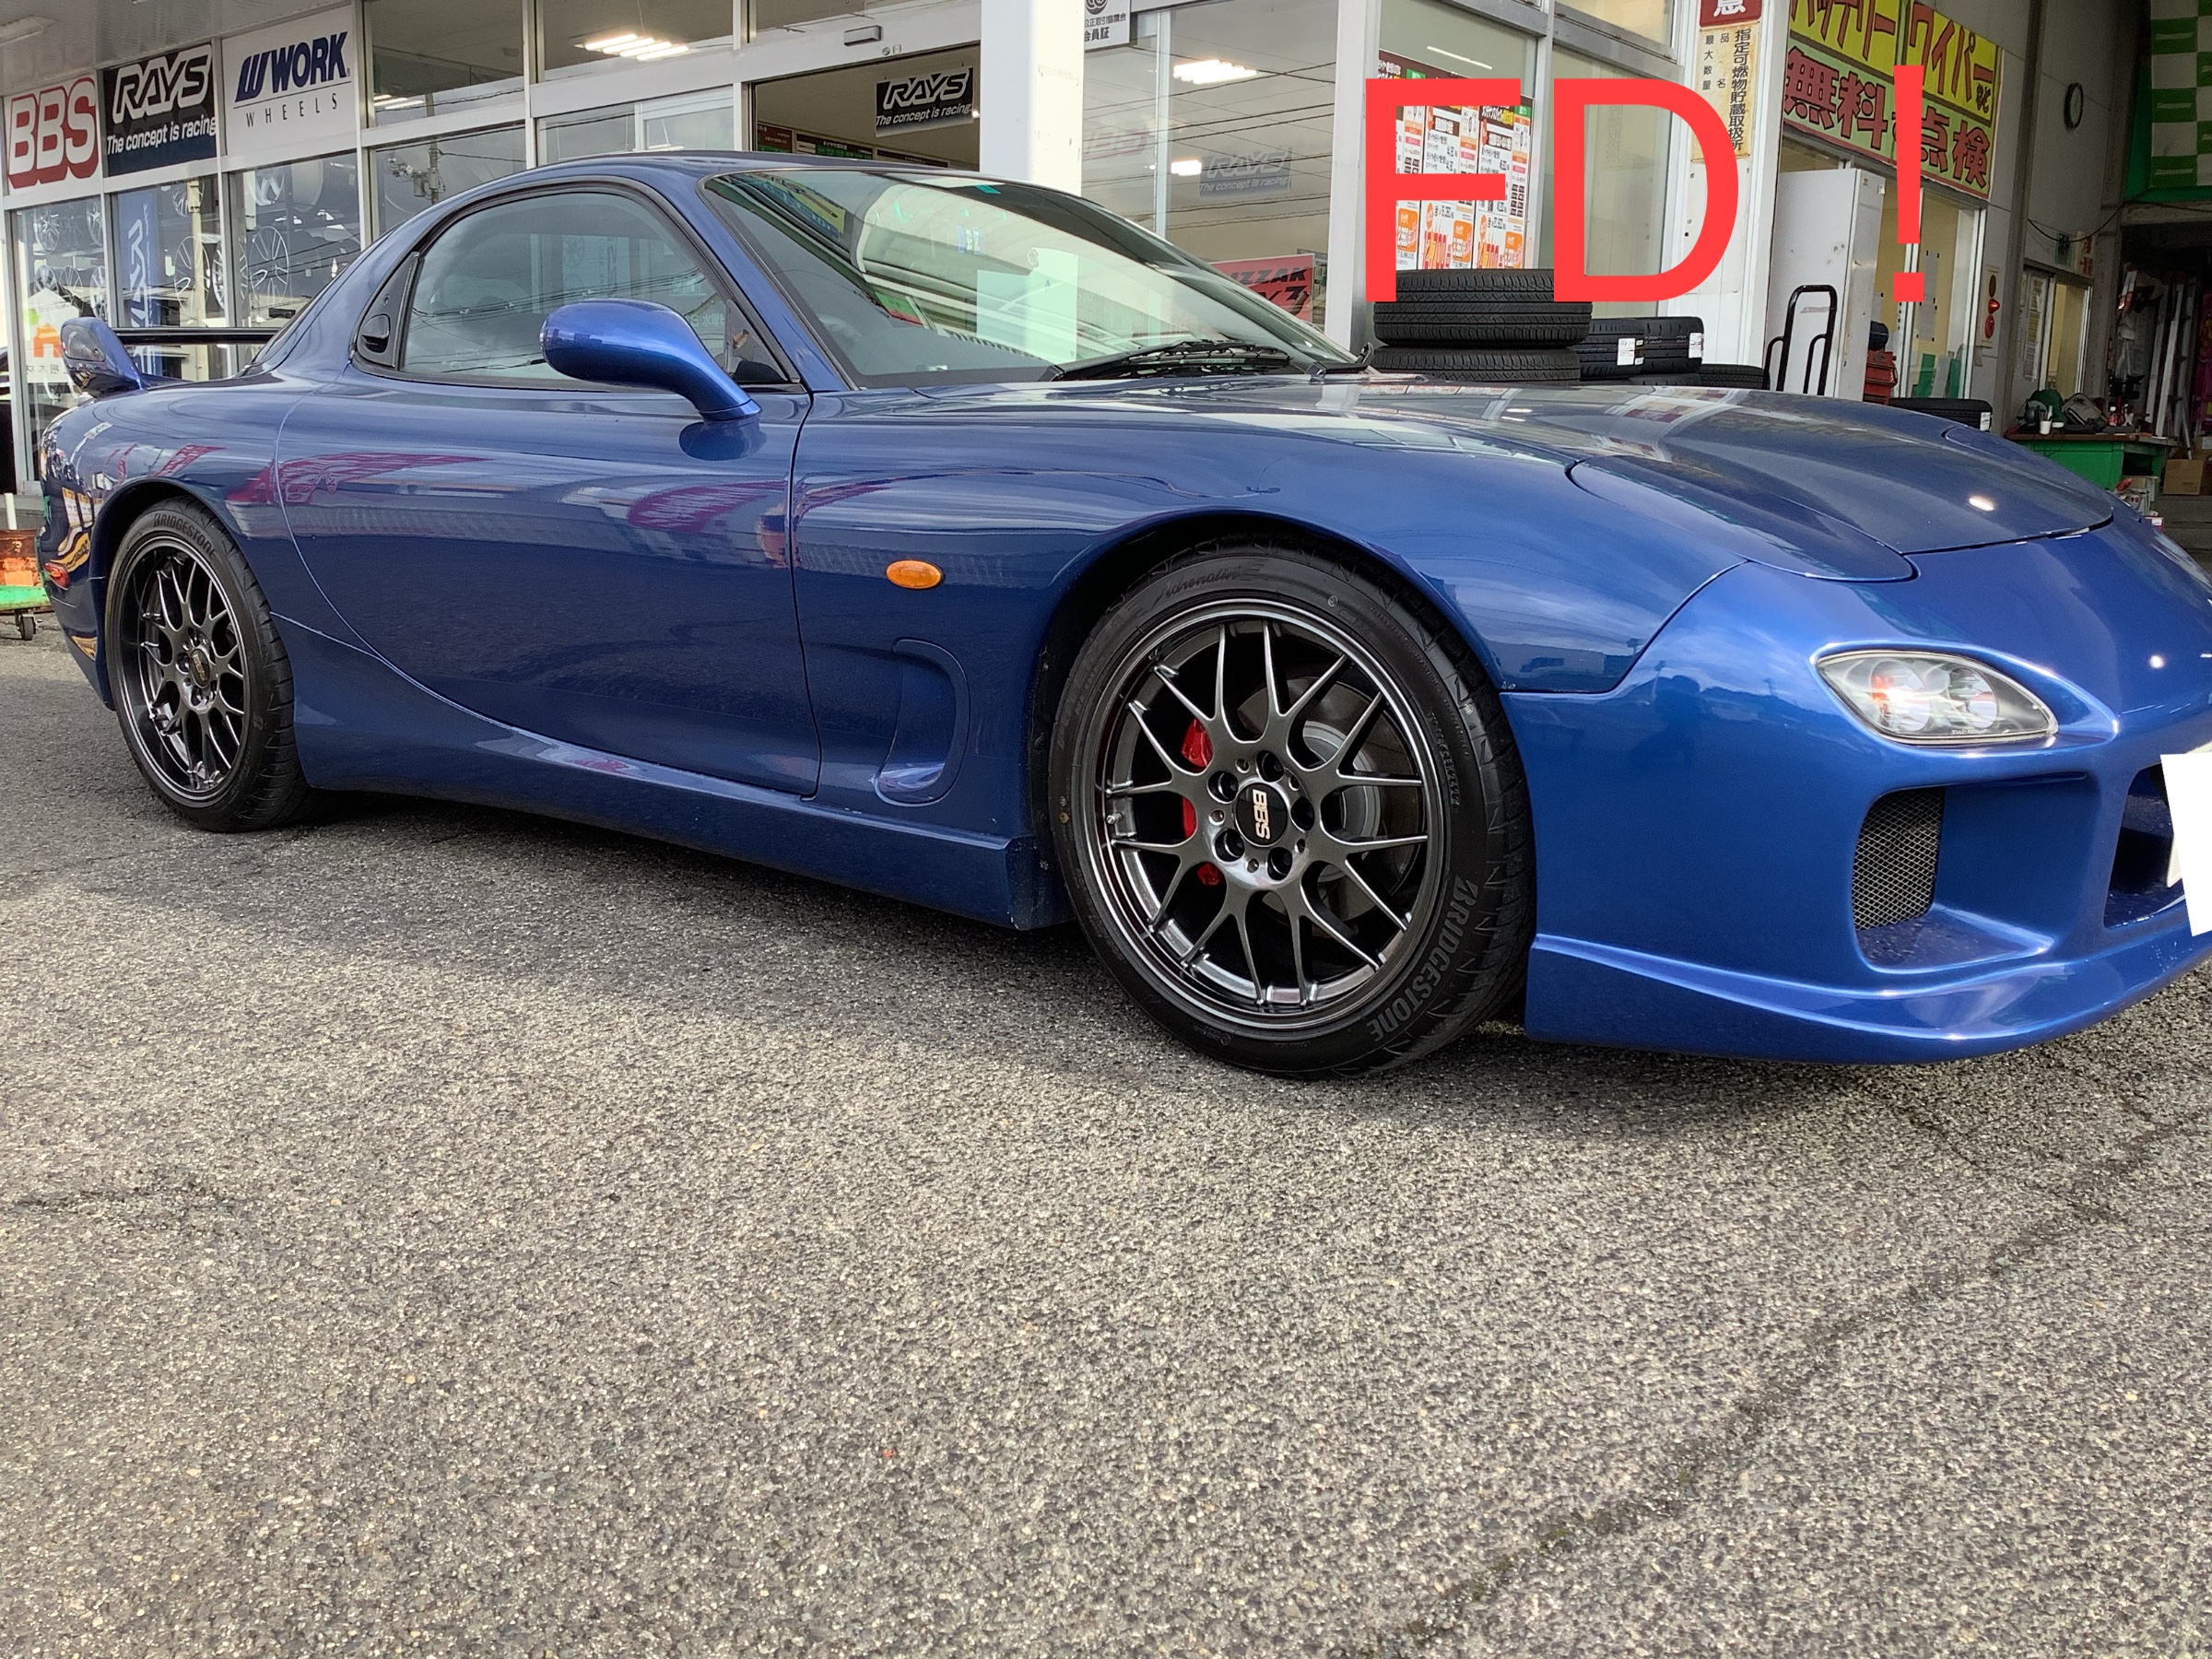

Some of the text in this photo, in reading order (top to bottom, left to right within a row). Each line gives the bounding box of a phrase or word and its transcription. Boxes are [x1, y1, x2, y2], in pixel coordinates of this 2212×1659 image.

[112, 45, 213, 124] RAYS
[271, 31, 348, 93] WORK
[245, 92, 337, 128] WHEELS
[883, 68, 970, 110] RAYS
[8, 77, 100, 189] BBS
[107, 114, 217, 155] The concept is racing
[876, 103, 972, 126] The concept is racing
[1783, 45, 1991, 189] 無料点検
[1200, 182, 1213, 192] The
[1215, 180, 1251, 192] concept
[1206, 151, 1289, 179] RAYS
[153, 512, 217, 558] BRIDGESTONE
[1252, 788, 1271, 840] BBS
[1365, 874, 1478, 1042] BRIDGESTONE
